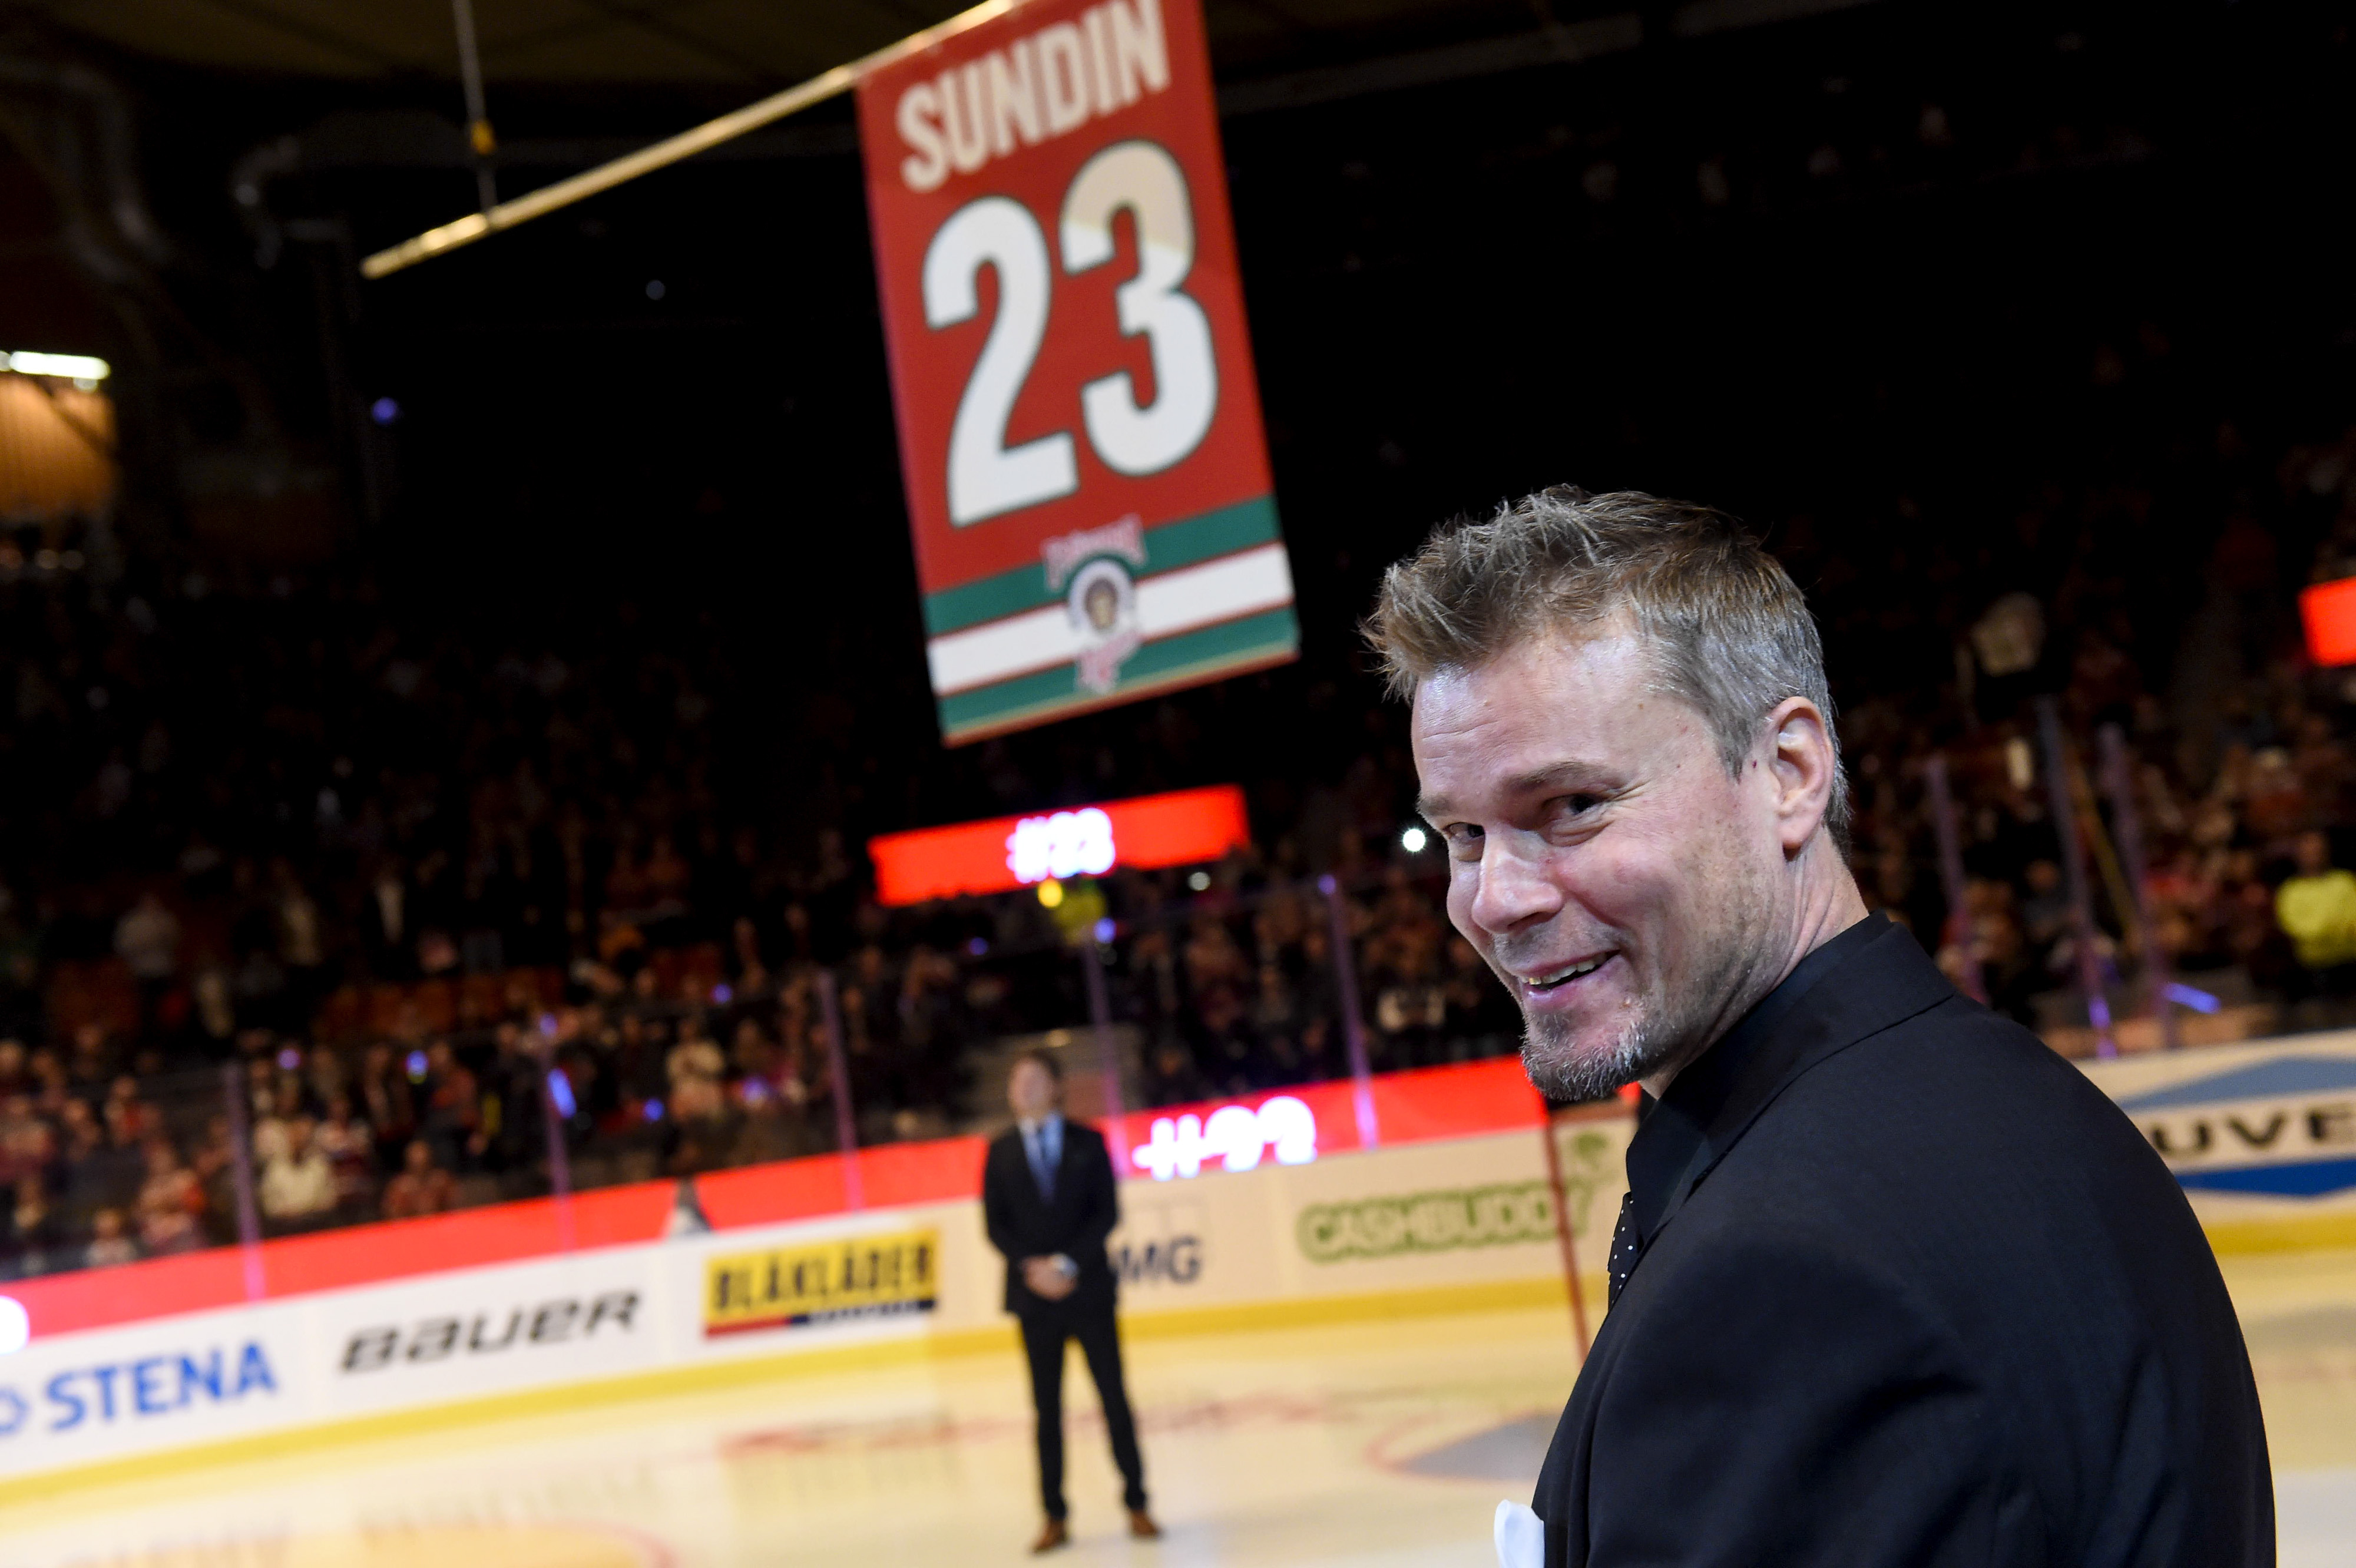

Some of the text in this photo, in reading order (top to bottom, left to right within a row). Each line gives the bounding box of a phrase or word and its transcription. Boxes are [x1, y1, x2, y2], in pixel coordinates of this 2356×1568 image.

[896, 0, 1170, 193] SUNDIN
[921, 139, 1219, 528] 23
[46, 1343, 277, 1431] STENA
